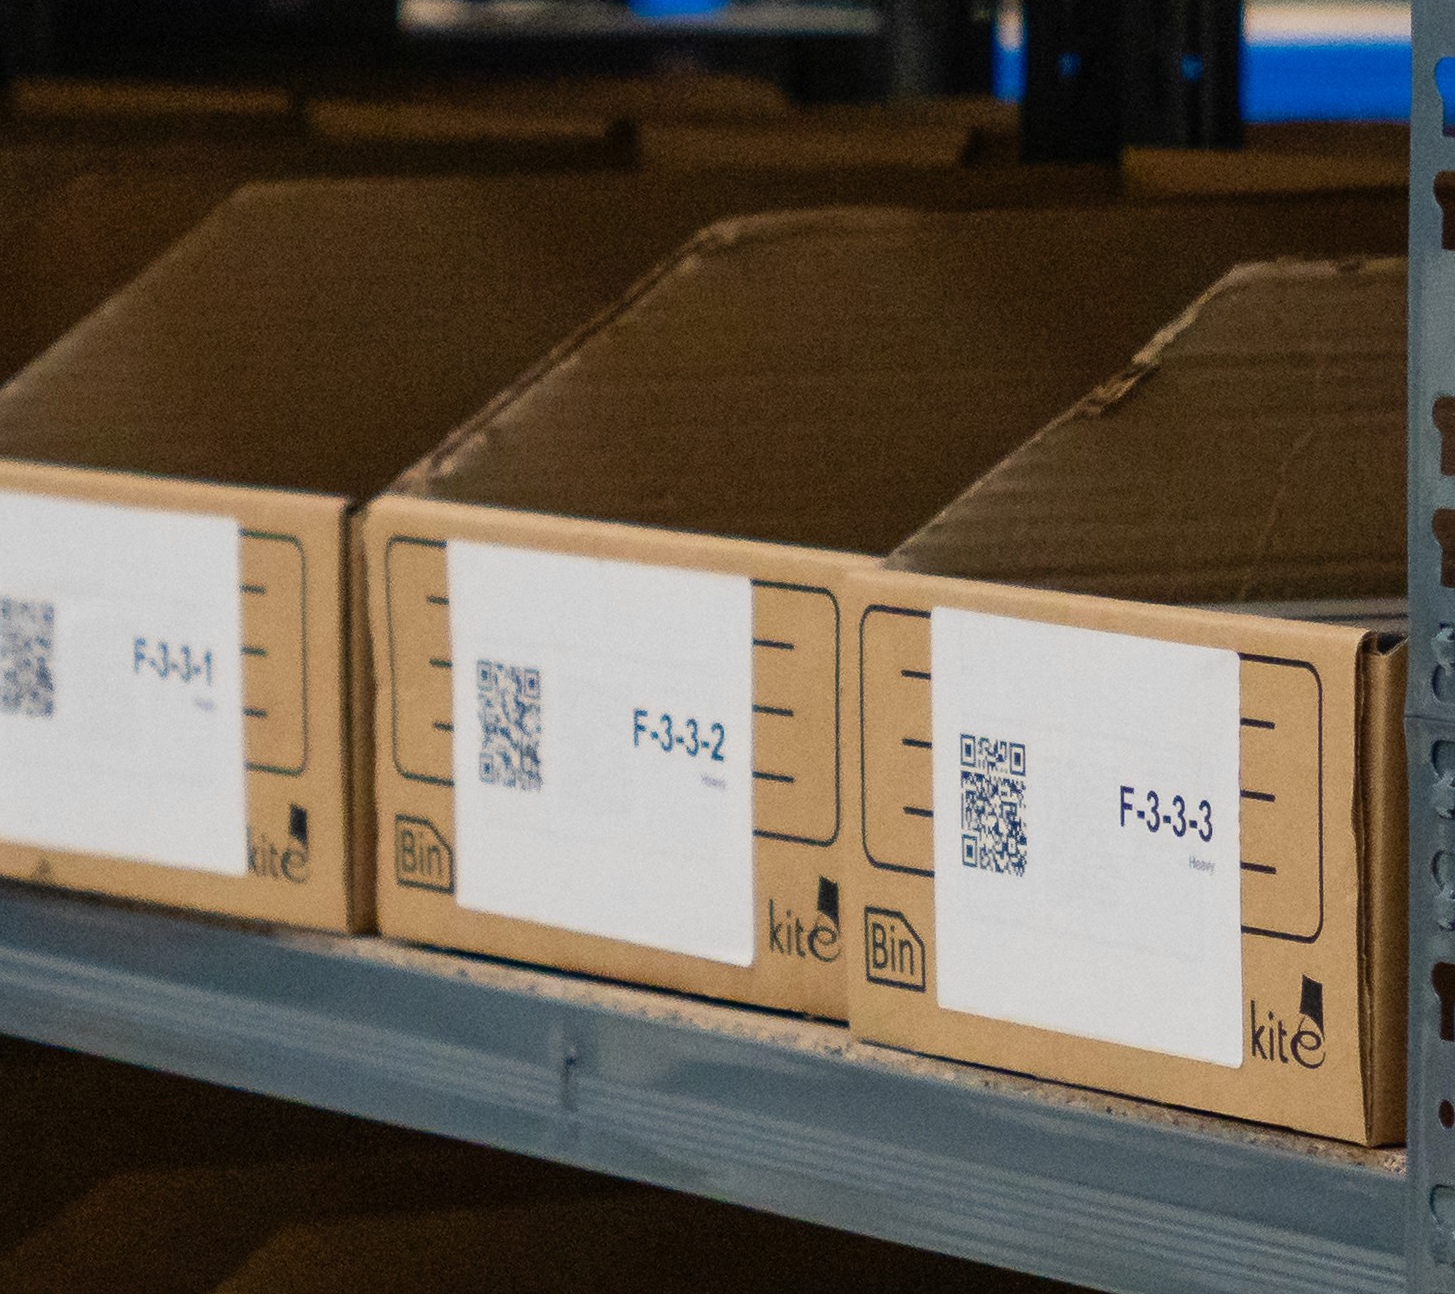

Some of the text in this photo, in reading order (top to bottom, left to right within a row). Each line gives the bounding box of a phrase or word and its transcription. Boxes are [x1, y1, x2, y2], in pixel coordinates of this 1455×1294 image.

[133, 637, 215, 686] F-3-3-1
[633, 710, 726, 763] F-3-3-2
[1120, 786, 1214, 841] F-3-3-3
[401, 825, 445, 879] Bin
[1188, 855, 1215, 874] Heavy
[769, 899, 841, 963] kite
[872, 925, 917, 975] Bin
[1251, 1000, 1325, 1069] kite
